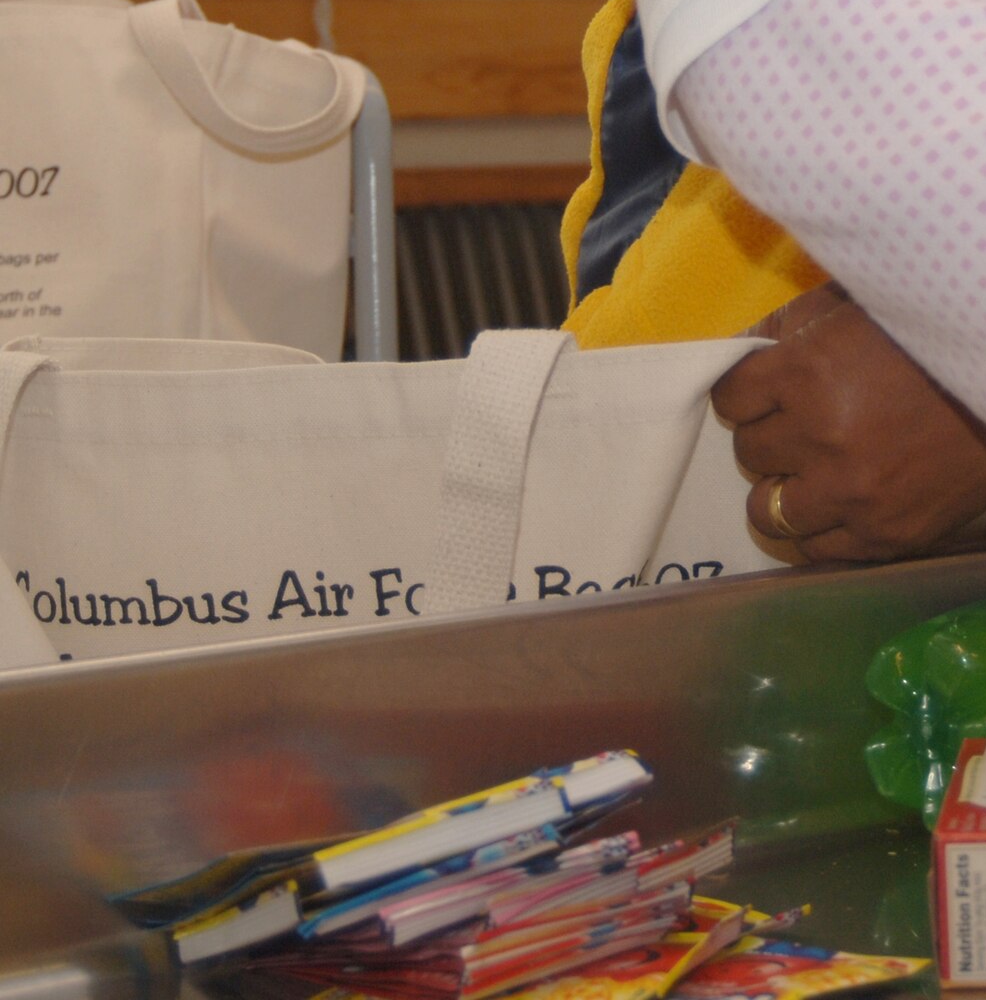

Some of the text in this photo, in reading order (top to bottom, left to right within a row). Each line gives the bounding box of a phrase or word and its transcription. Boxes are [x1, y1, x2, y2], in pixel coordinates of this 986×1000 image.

[35, 252, 60, 267] per
[27, 287, 43, 302] of
[39, 303, 62, 317] the
[16, 569, 250, 627] olumbus
[267, 569, 355, 620] Air
[955, 853, 973, 973] Nutrition Facts
